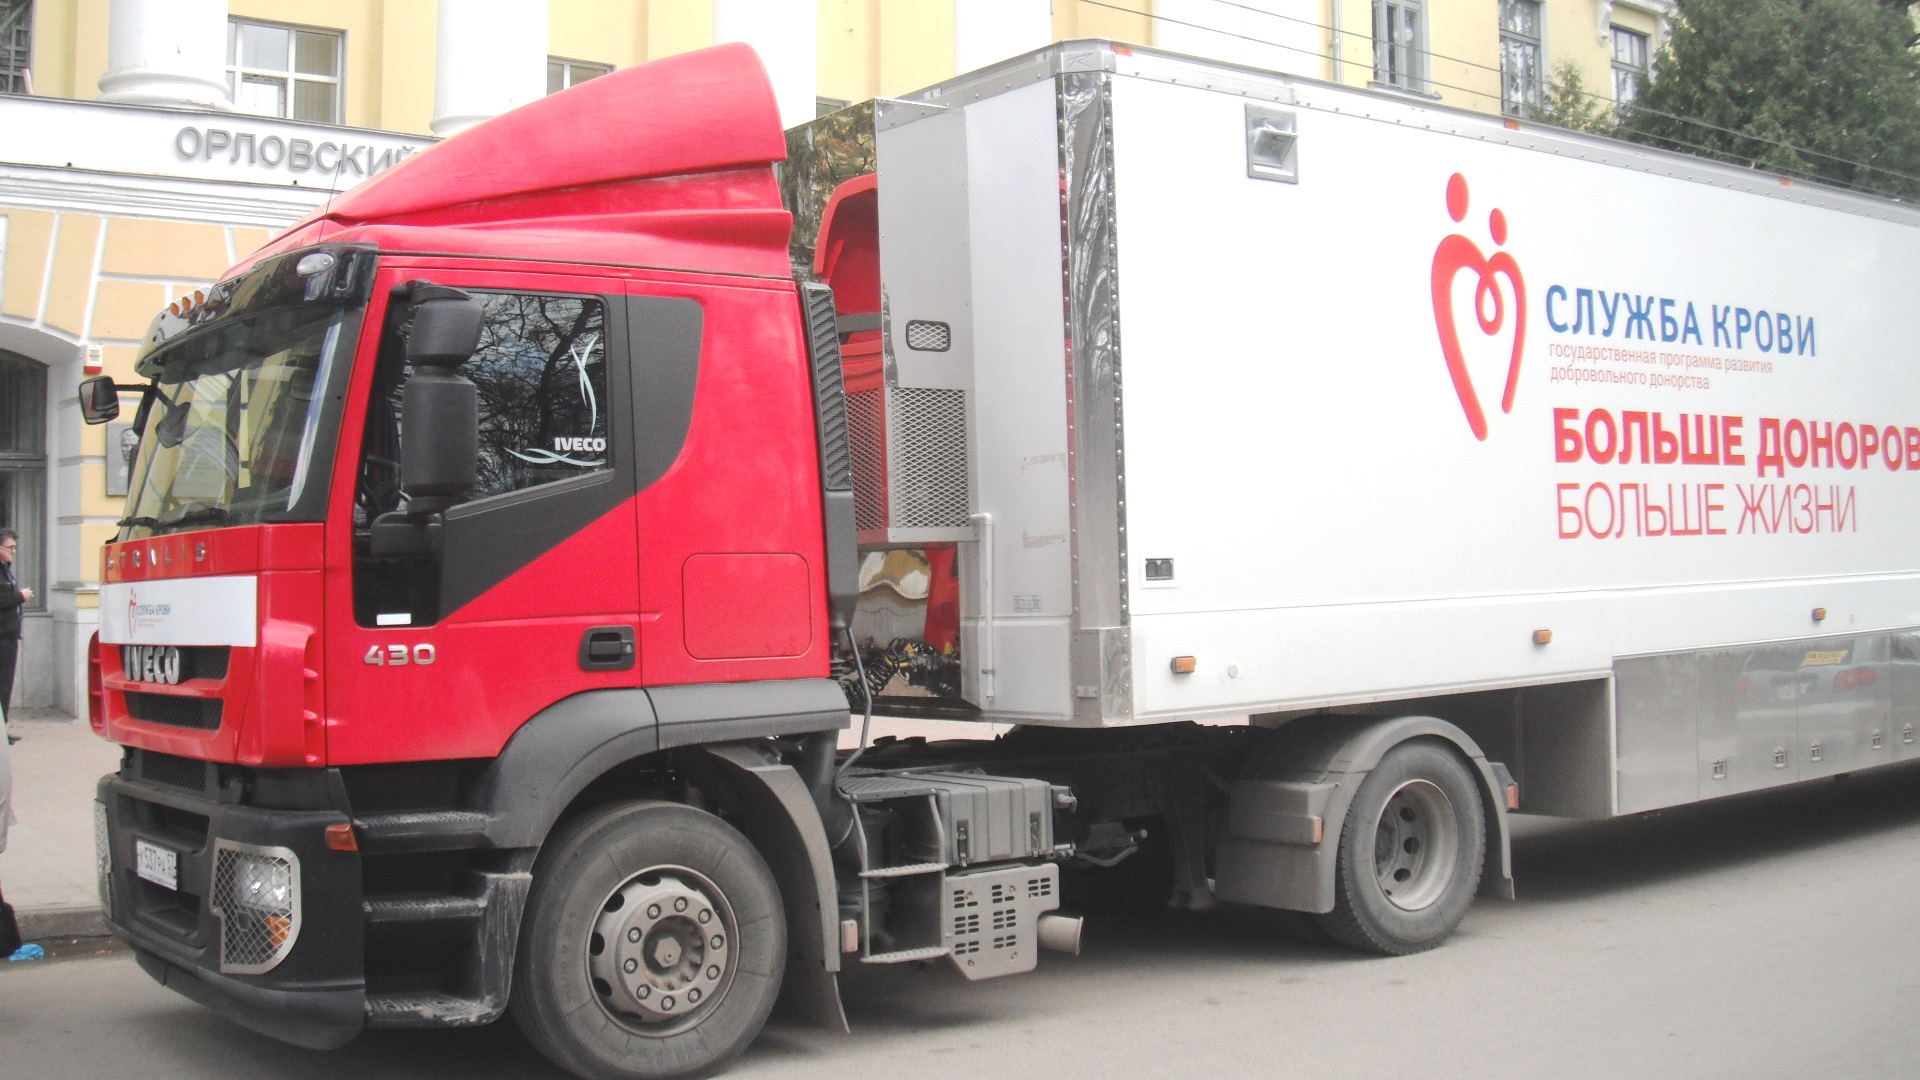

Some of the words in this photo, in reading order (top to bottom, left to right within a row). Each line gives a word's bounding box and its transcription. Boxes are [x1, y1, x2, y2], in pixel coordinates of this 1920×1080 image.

[1546, 284, 1703, 346] СЛУЖБА
[1711, 303, 1816, 357] КРОВИ
[1549, 343, 1657, 364] государственная
[1659, 352, 1723, 371] программа
[1724, 357, 1774, 374] развития
[1550, 364, 1647, 386] добровольного
[1649, 373, 1711, 391] донорства
[554, 437, 607, 452] IVECO
[1553, 407, 1745, 466] БОЛЬШЕ
[1756, 417, 1920, 478] ДОНОРОВ
[1556, 481, 1727, 540] БОЛЬШЕ
[1735, 483, 1857, 535] ЖИЗНИ
[107, 542, 206, 571] STRALIS
[124, 645, 181, 685] IVECO
[363, 643, 436, 667] 430
